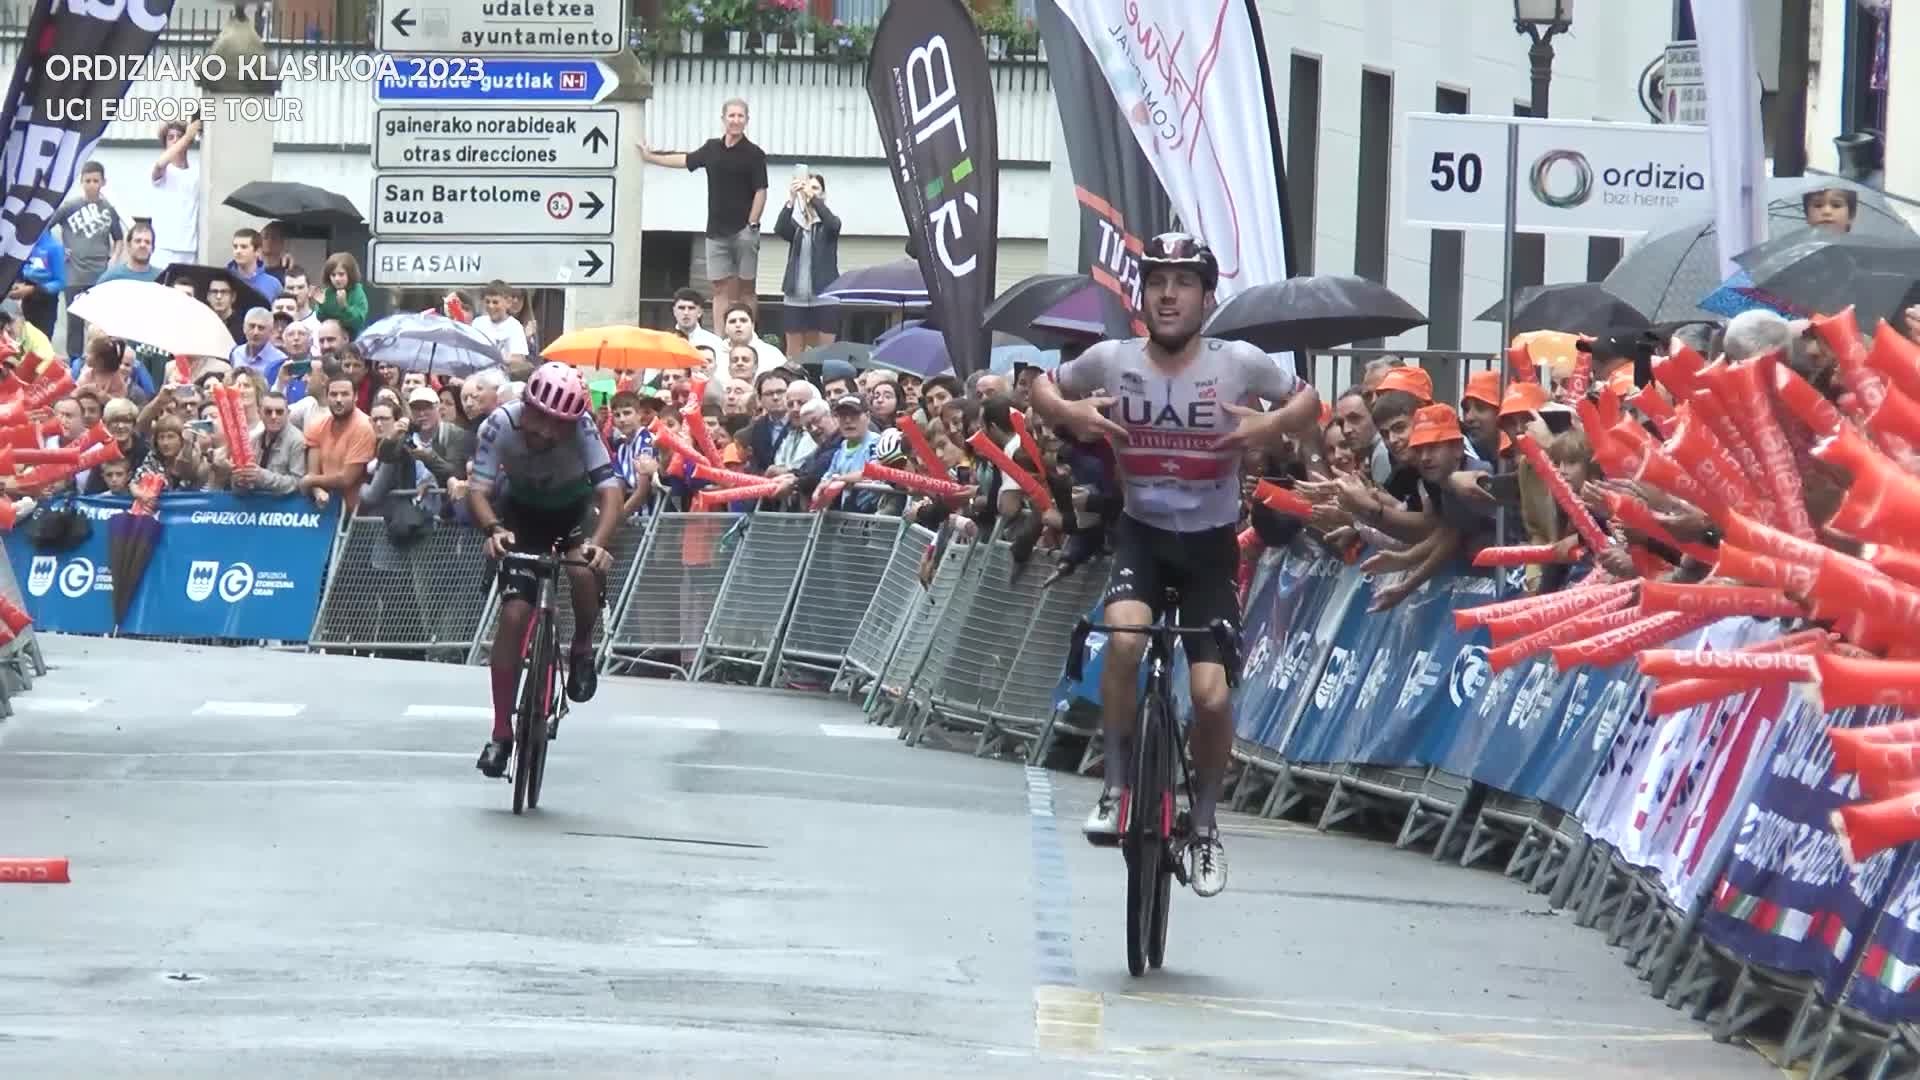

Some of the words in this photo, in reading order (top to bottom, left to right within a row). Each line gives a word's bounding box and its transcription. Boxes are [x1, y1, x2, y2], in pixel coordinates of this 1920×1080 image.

[482, 0, 595, 16] udaletxea
[461, 29, 613, 46] ayuntamiento
[480, 72, 554, 92] guztiak
[385, 117, 472, 136] gainerako
[477, 117, 576, 134] norabideak
[403, 147, 451, 162] otras
[456, 145, 557, 162] direcciones
[1430, 152, 1482, 192] 50
[1603, 161, 1704, 190] ordizia
[385, 185, 424, 202] San
[432, 185, 541, 202] Bartolome
[383, 210, 444, 224] auzoa
[381, 256, 481, 272] BEASAIN
[1122, 395, 1216, 428] UAE
[191, 510, 256, 526] GIPUZKOA
[258, 512, 320, 528] KIROLAK
